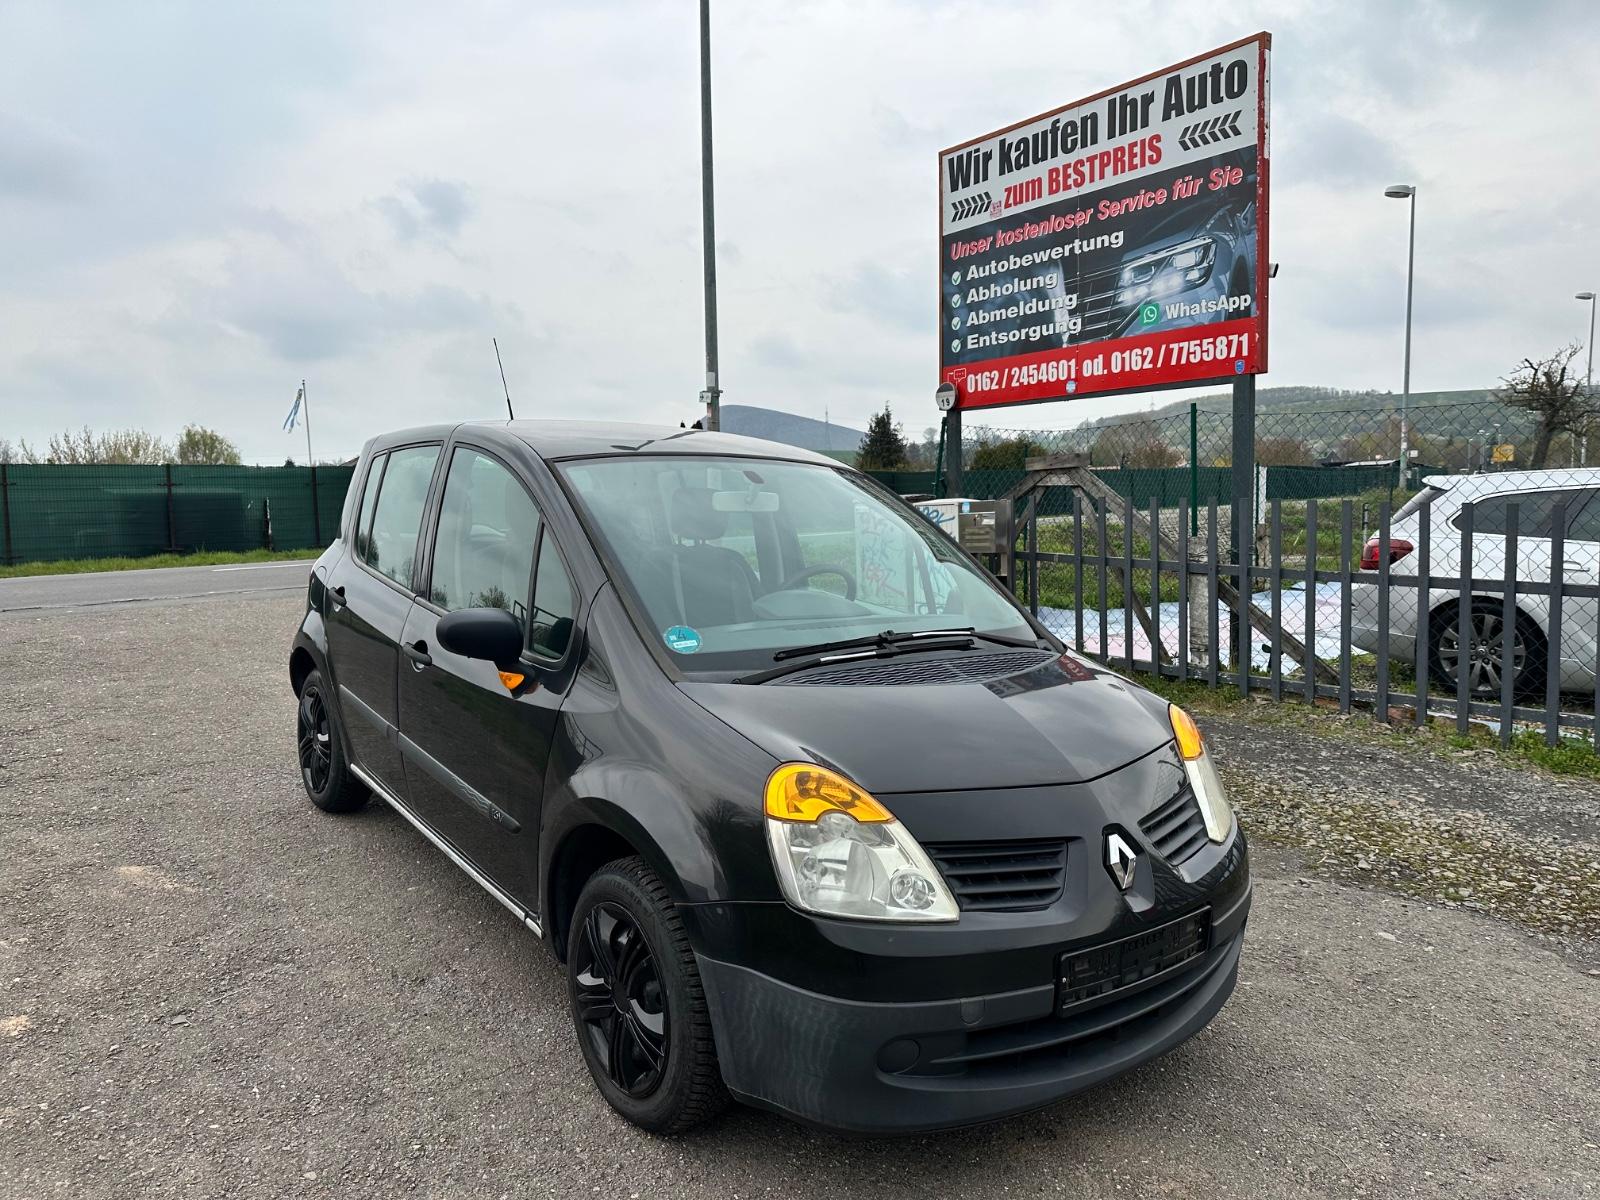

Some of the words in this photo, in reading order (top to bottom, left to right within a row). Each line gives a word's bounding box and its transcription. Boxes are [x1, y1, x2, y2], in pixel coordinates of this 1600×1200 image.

[948, 147, 992, 193] Wir
[999, 110, 1098, 176] kaufen
[1107, 90, 1154, 140] Ihr
[1162, 59, 1248, 122] Auto
[1003, 176, 1042, 209] zum
[1048, 133, 1162, 196] BESTPREIS
[950, 234, 992, 261] Unser
[996, 208, 1093, 246] kostenloser
[1098, 188, 1167, 220] Service
[1171, 175, 1203, 205] für
[1208, 165, 1243, 192] Sie
[966, 229, 1125, 282] Autobewertung
[966, 270, 1059, 305] Abholung
[966, 291, 1078, 328] Abmeldung
[1165, 293, 1252, 320] WhatsApp
[966, 316, 1082, 350] Entsorgung
[967, 370, 999, 393] 0162
[1011, 358, 1076, 388] 2454601
[1082, 354, 1108, 377] od.
[1111, 346, 1153, 373] 0162
[1169, 333, 1249, 366] 7755871
[941, 398, 950, 407] 19
